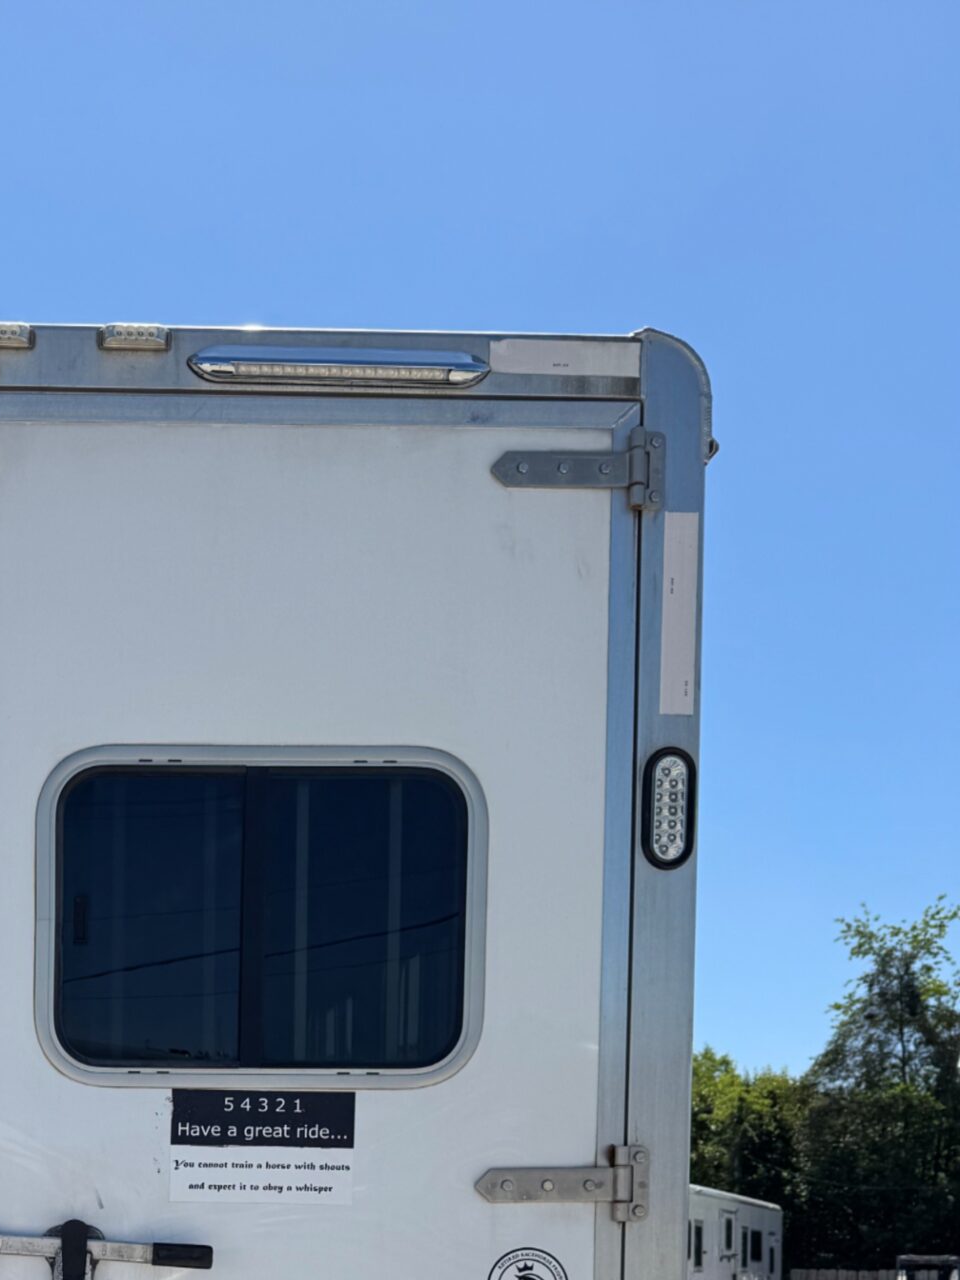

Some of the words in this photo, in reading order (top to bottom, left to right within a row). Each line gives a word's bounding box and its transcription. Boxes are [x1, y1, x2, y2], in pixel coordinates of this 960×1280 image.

[223, 1097, 234, 1112] 5
[240, 1097, 251, 1112] 4
[258, 1097, 268, 1112] 3
[275, 1098, 286, 1112] 2
[294, 1099, 302, 1113] 1
[177, 1122, 221, 1136] Have
[227, 1125, 237, 1136] a
[244, 1124, 290, 1140] great
[296, 1124, 348, 1139] ride...
[174, 1159, 195, 1170] You
[198, 1161, 228, 1169] cannot
[231, 1161, 254, 1169] train
[265, 1161, 291, 1170] horse
[294, 1161, 316, 1171] with
[319, 1162, 351, 1171] shouts
[188, 1182, 205, 1190] and
[208, 1183, 236, 1193] expect
[239, 1183, 246, 1191] it
[250, 1183, 259, 1191] to
[262, 1183, 283, 1194] obey
[295, 1183, 333, 1194] whisper
